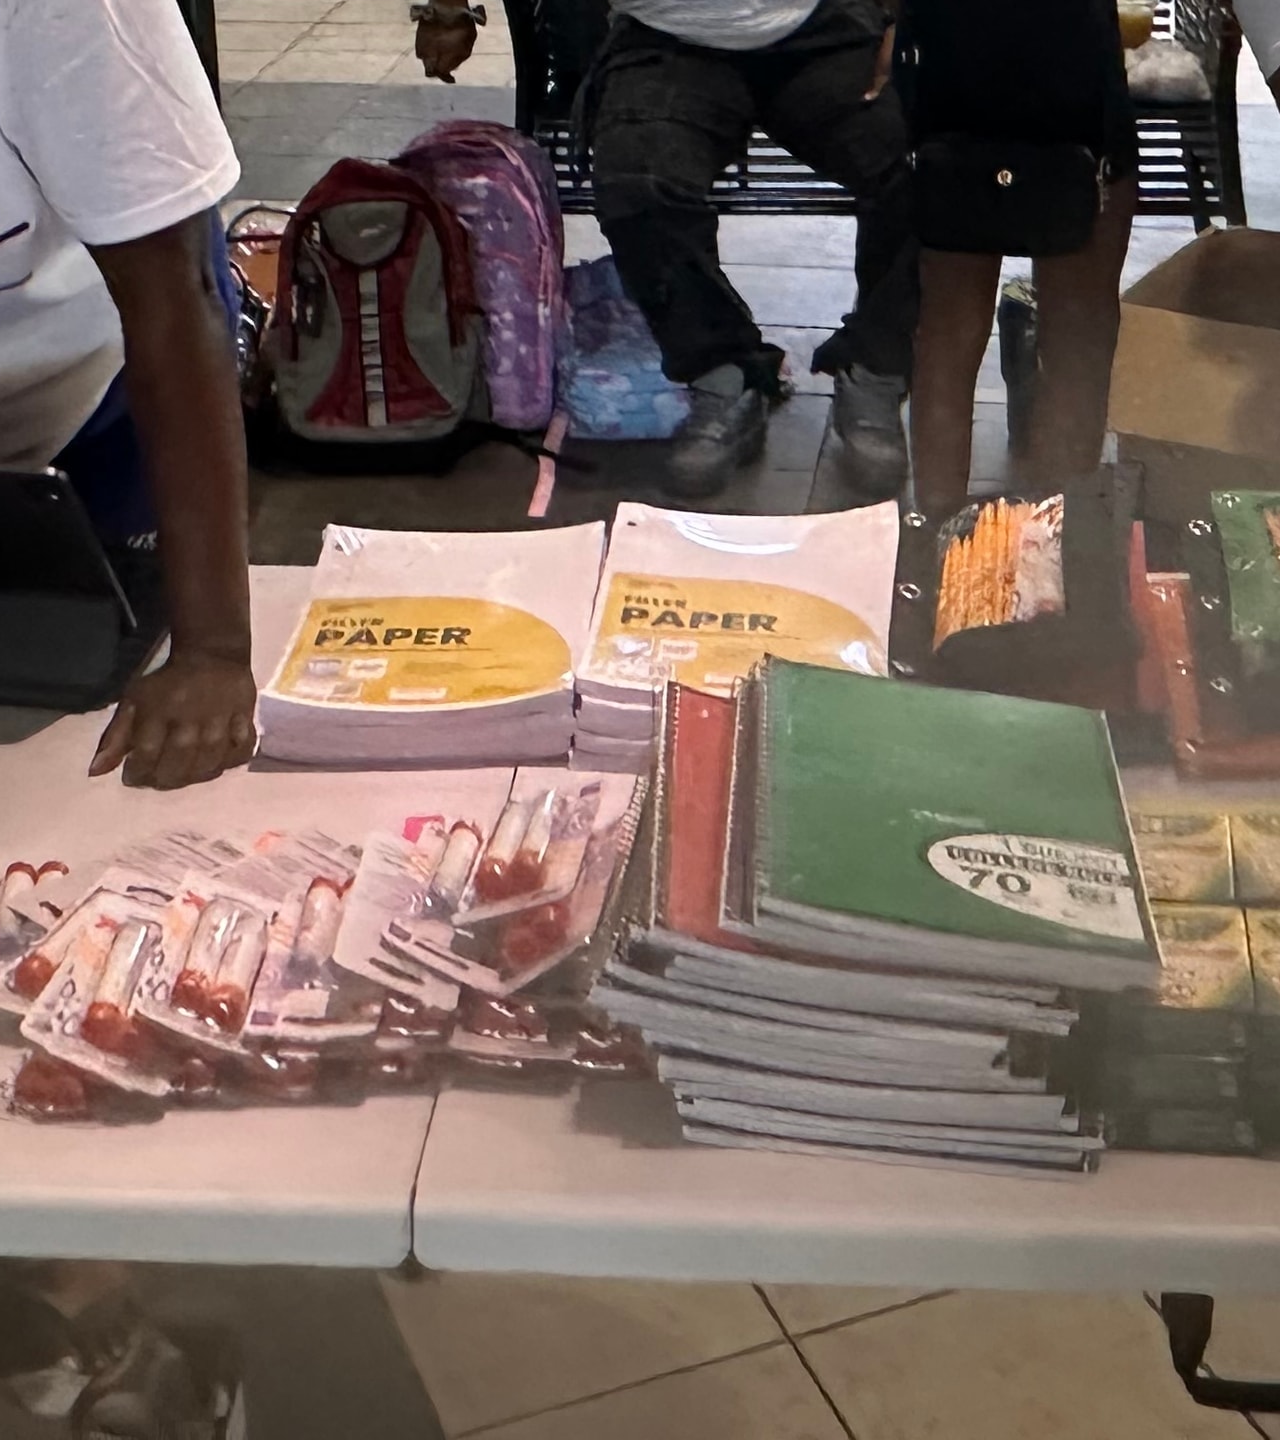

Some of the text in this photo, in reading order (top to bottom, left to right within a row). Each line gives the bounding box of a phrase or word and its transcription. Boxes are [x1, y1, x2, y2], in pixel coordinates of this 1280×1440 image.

[621, 607, 778, 633] PAPER
[314, 626, 472, 647] PAPER
[958, 865, 1032, 894] 70
